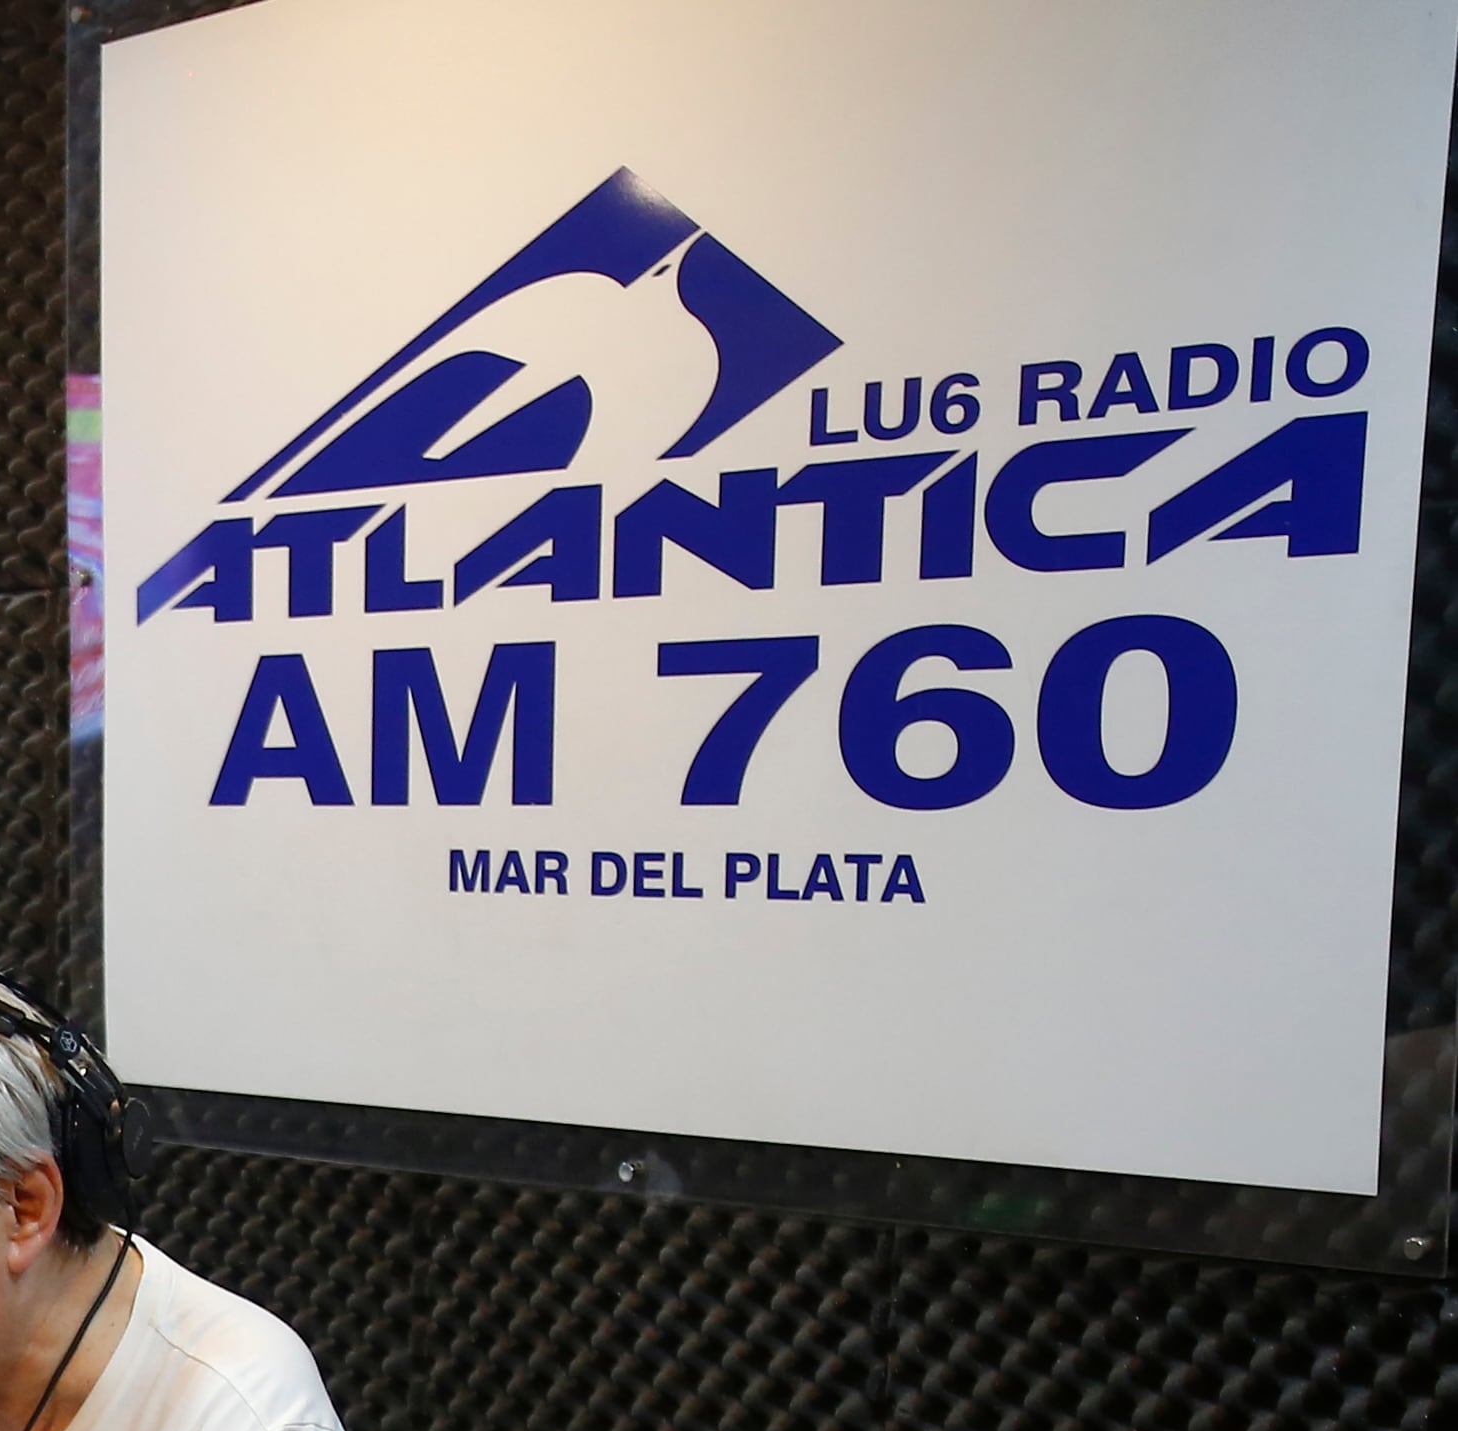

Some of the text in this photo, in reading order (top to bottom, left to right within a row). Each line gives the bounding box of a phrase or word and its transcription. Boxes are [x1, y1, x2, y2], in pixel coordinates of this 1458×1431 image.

[811, 325, 1371, 447] LU6 RADIO
[137, 409, 1370, 627] ATLANTICA
[207, 613, 1240, 811] AM 760
[447, 848, 926, 904] MAR DEL PLATA
